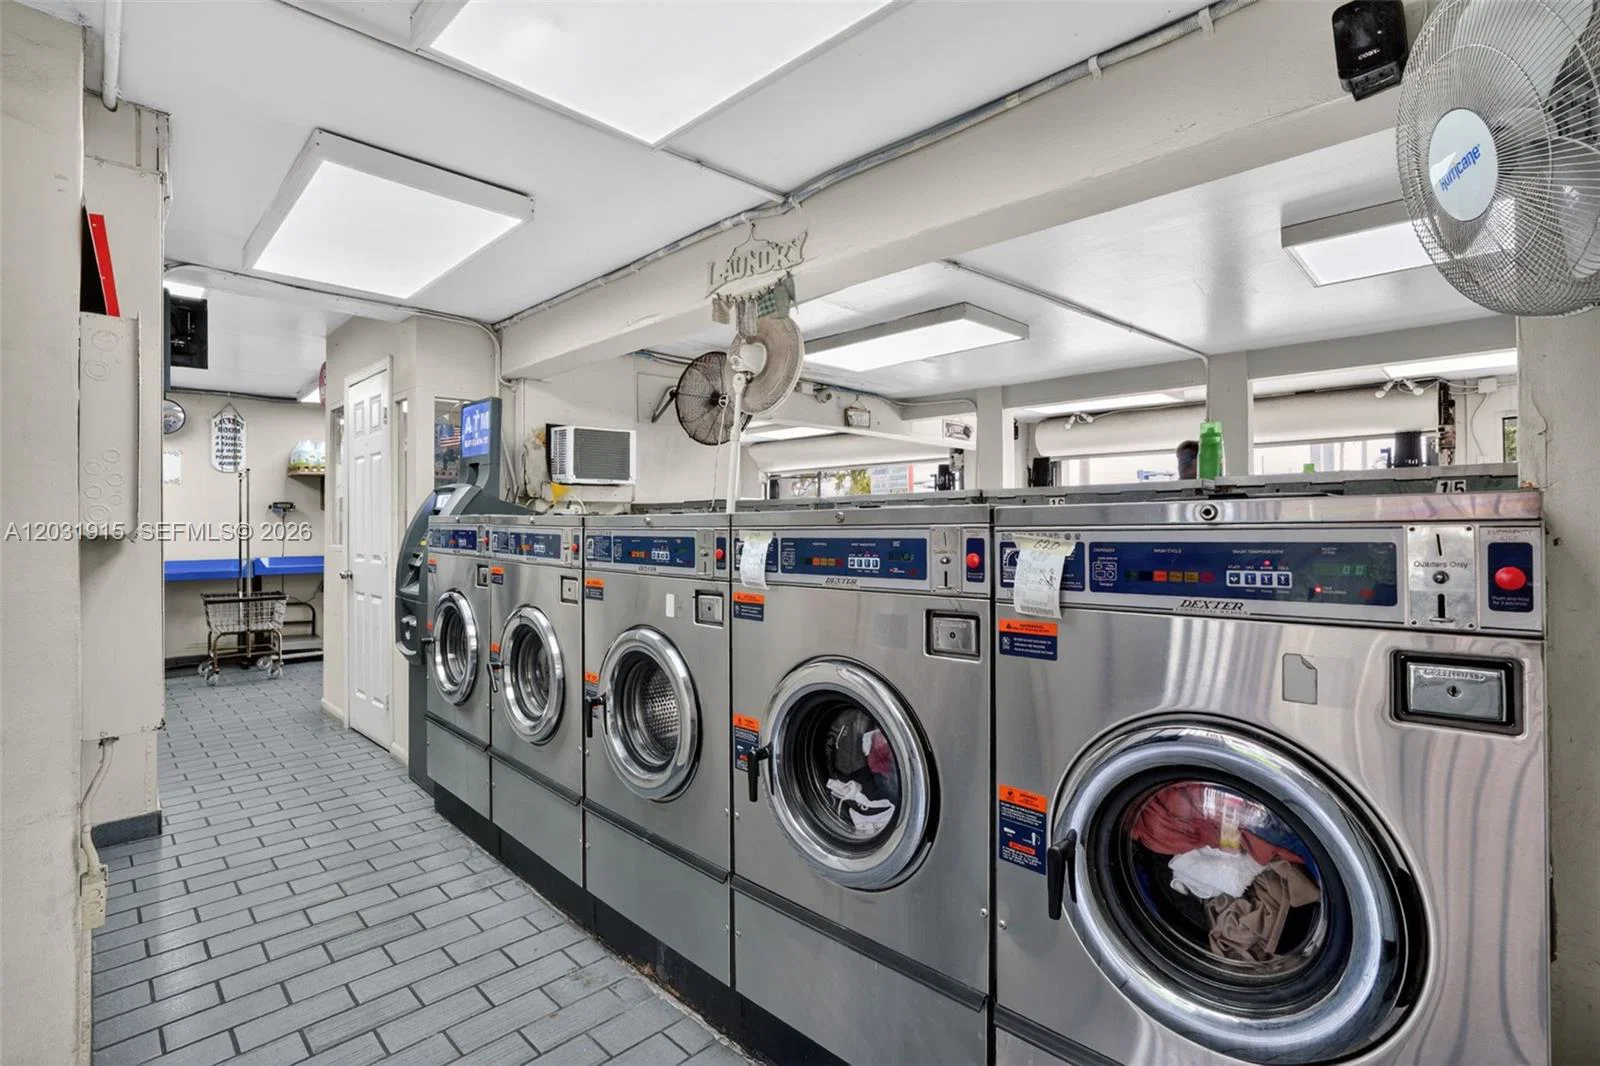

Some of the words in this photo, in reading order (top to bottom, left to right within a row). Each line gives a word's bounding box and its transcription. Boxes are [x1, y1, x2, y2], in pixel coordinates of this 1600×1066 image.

[1439, 145, 1481, 191] Hurricane
[706, 231, 808, 286] LAUNDRY
[464, 410, 490, 435] ATM
[1438, 480, 1467, 493] 15
[1413, 560, 1447, 568] Quarters
[1449, 560, 1469, 569] Only
[1180, 599, 1245, 611] DEXTER
